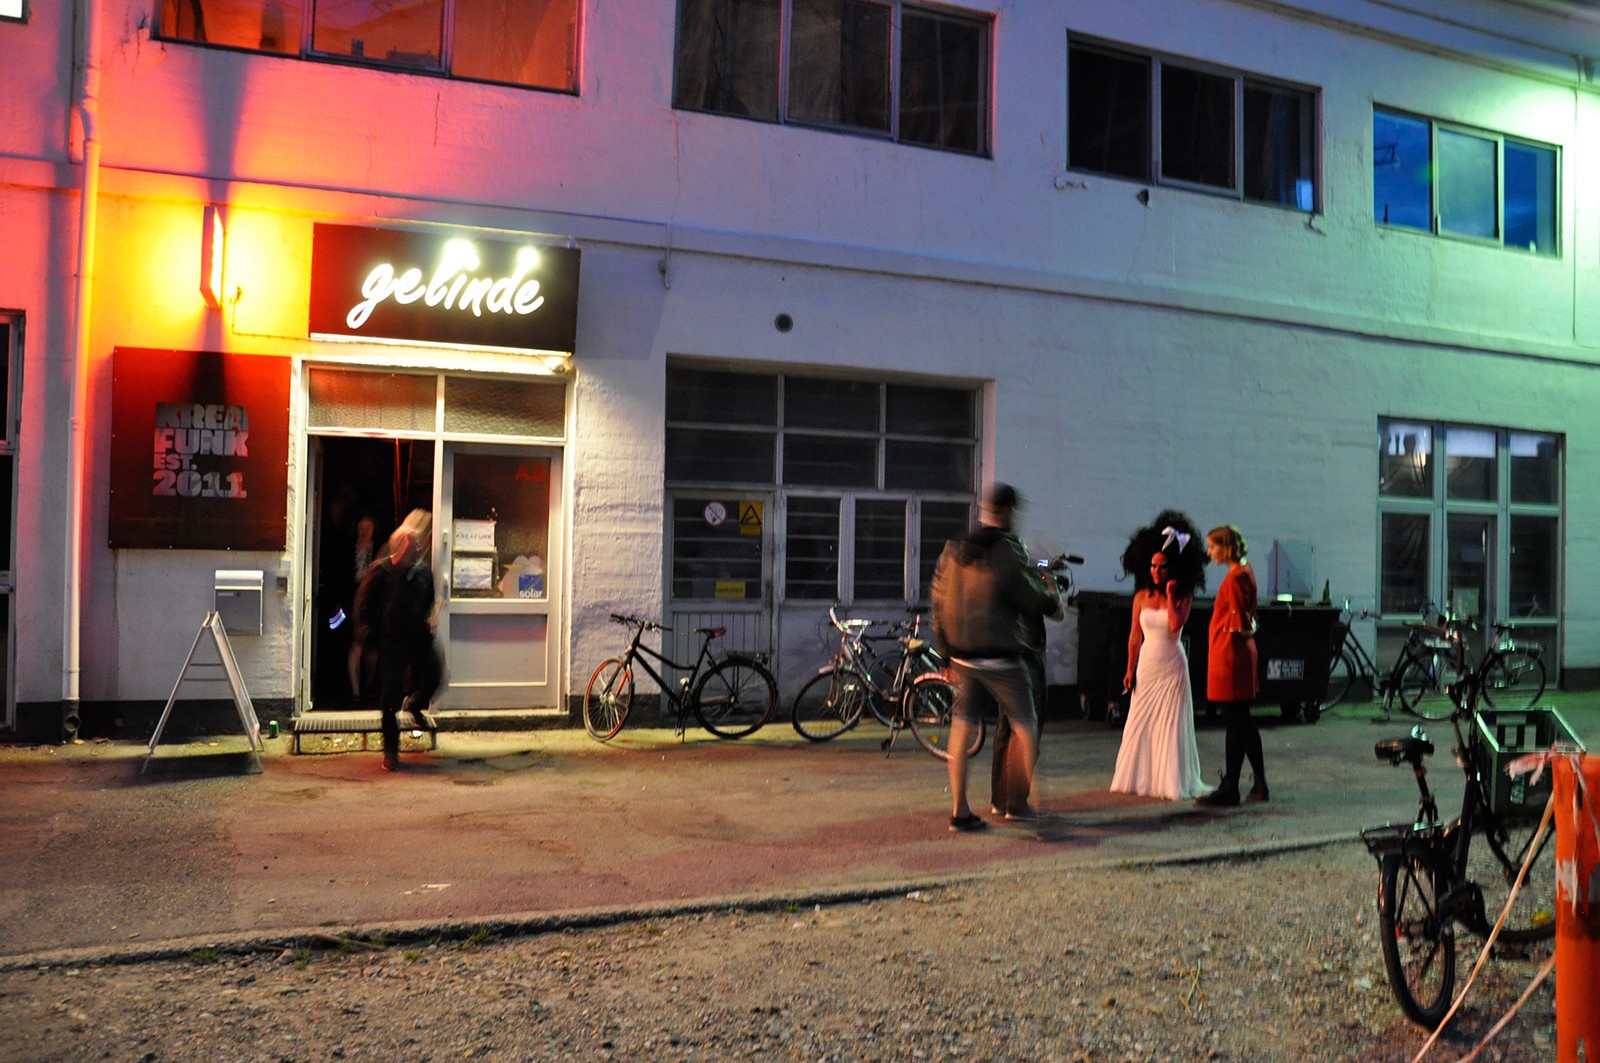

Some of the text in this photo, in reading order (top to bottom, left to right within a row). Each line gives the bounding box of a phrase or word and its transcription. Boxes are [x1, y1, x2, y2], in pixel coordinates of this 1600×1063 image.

[346, 239, 545, 329] gelinde
[155, 402, 249, 431] KREA
[153, 427, 249, 457] FUNK
[153, 453, 198, 470] EST.
[152, 469, 248, 498] 2011
[519, 588, 543, 599] solar
